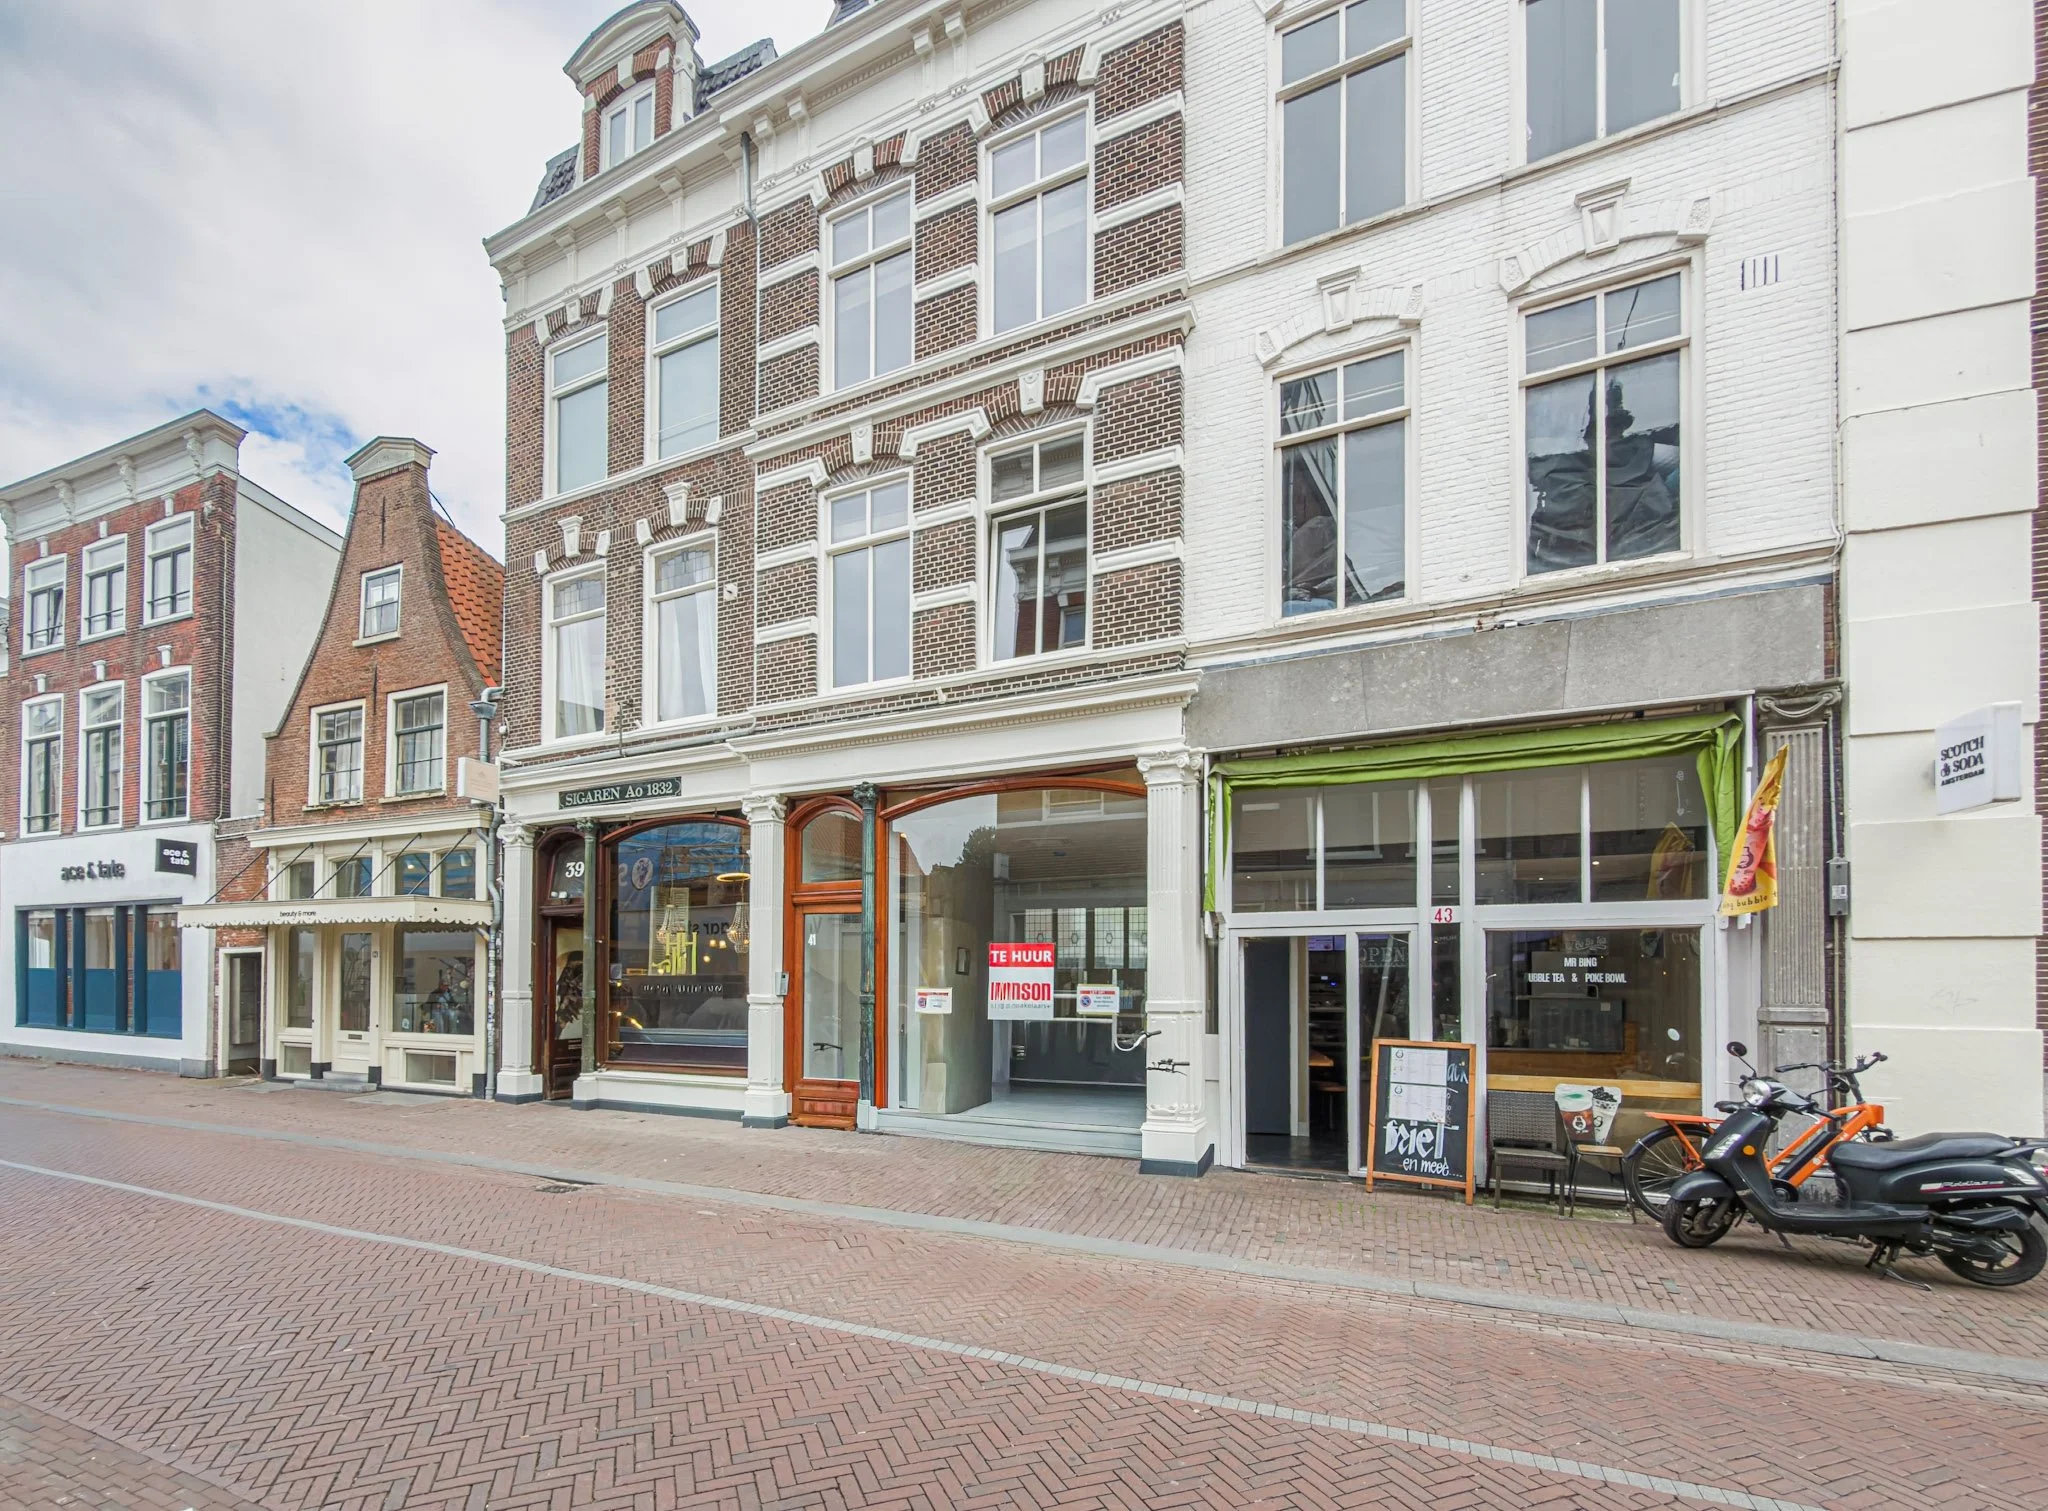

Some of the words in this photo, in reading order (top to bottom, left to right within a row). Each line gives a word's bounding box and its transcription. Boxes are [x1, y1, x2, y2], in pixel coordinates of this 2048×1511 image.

[1941, 735, 1984, 761] SCOTCH
[1941, 762, 1950, 777] &
[1953, 752, 1984, 772] SODA
[1941, 768, 1985, 786] AMSTERDAM
[565, 786, 620, 806] SIGAREN
[647, 781, 673, 795] 1832
[163, 848, 180, 857] ace
[182, 850, 189, 858] &
[171, 856, 190, 866] tate
[61, 865, 85, 880] ace
[87, 861, 97, 879] &
[98, 860, 125, 878] tate
[565, 861, 585, 878] 39
[1435, 908, 1452, 923] 43
[808, 933, 816, 946] 41
[991, 950, 1007, 962] TE
[1012, 950, 1052, 962] HUUR
[1564, 957, 1576, 967] MR
[1579, 957, 1597, 967] BING
[1524, 973, 1550, 983] UBBLE
[1552, 973, 1564, 983] TEA
[1572, 972, 1578, 983] &
[1585, 973, 1603, 983] POKE
[1605, 973, 1627, 983] BOWL
[1403, 1158, 1417, 1171] en
